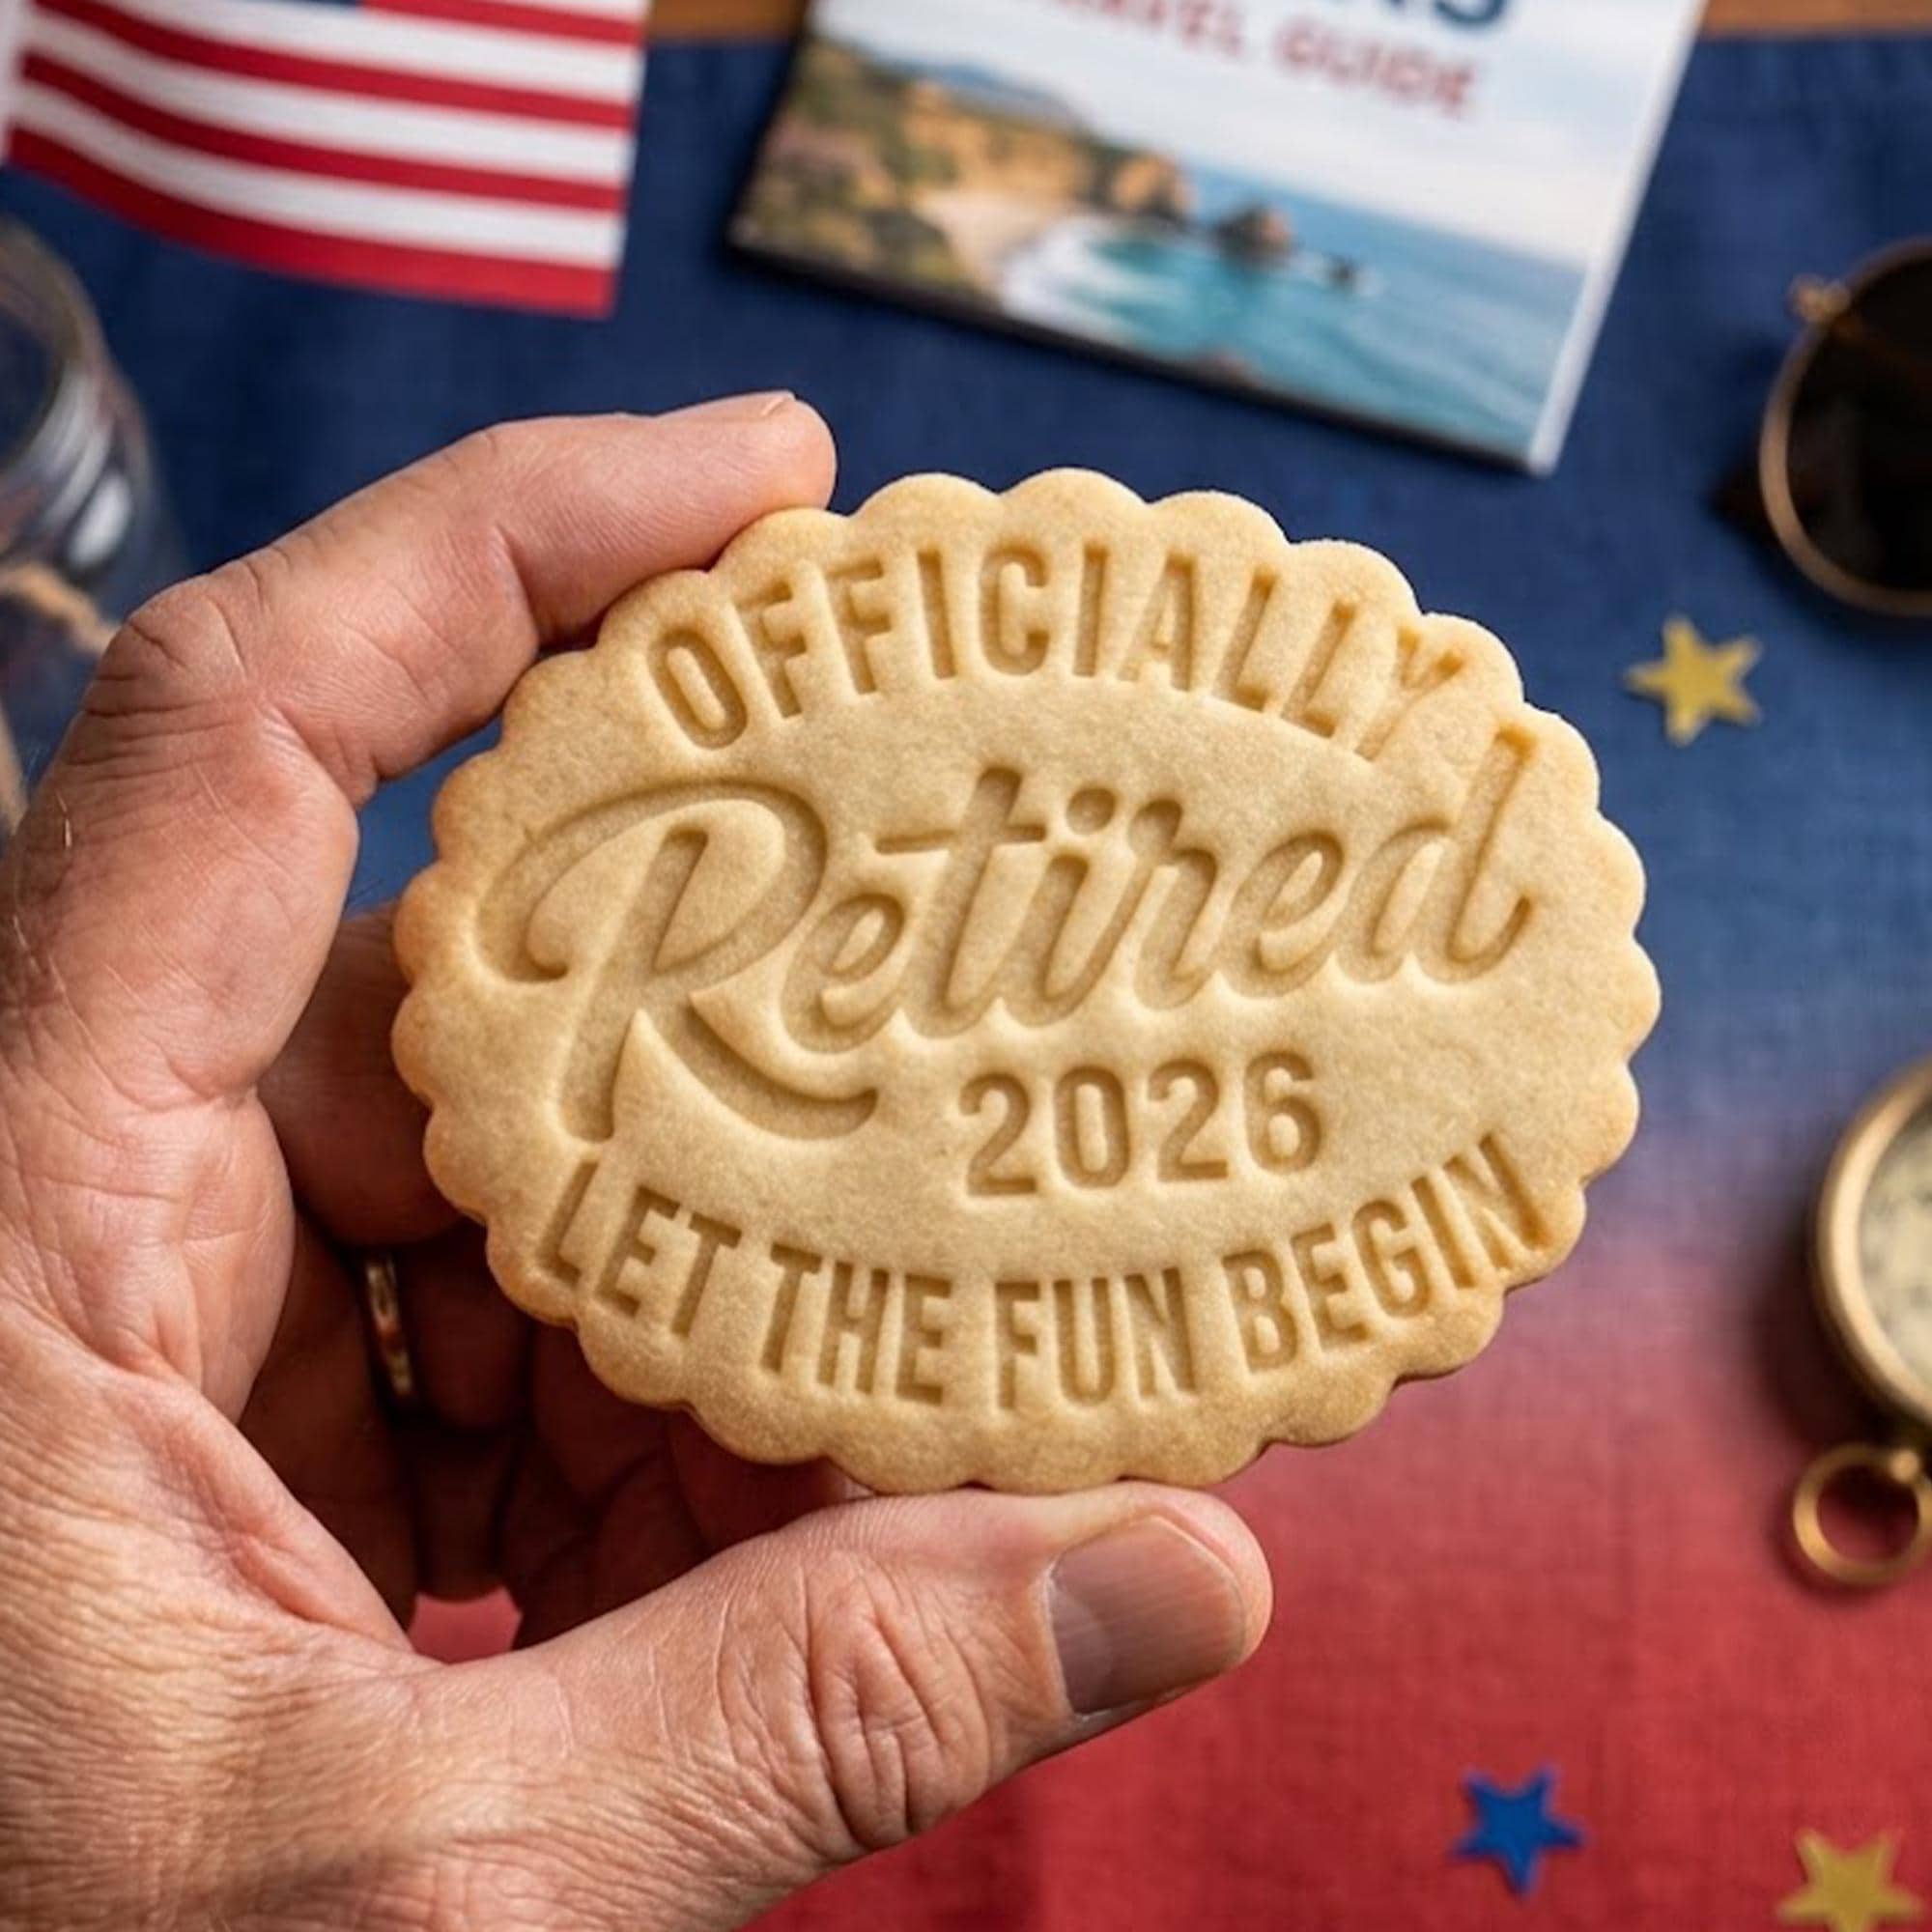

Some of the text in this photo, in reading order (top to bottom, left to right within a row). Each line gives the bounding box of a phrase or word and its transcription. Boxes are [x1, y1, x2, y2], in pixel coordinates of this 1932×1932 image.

[1273, 14, 1476, 116] GUIDE
[647, 538, 1465, 762] OFFICIALLY
[475, 721, 1538, 1141] Retired
[958, 1052, 1324, 1196] 2026
[536, 1133, 1548, 1410] LET THE FUN BEGIN
